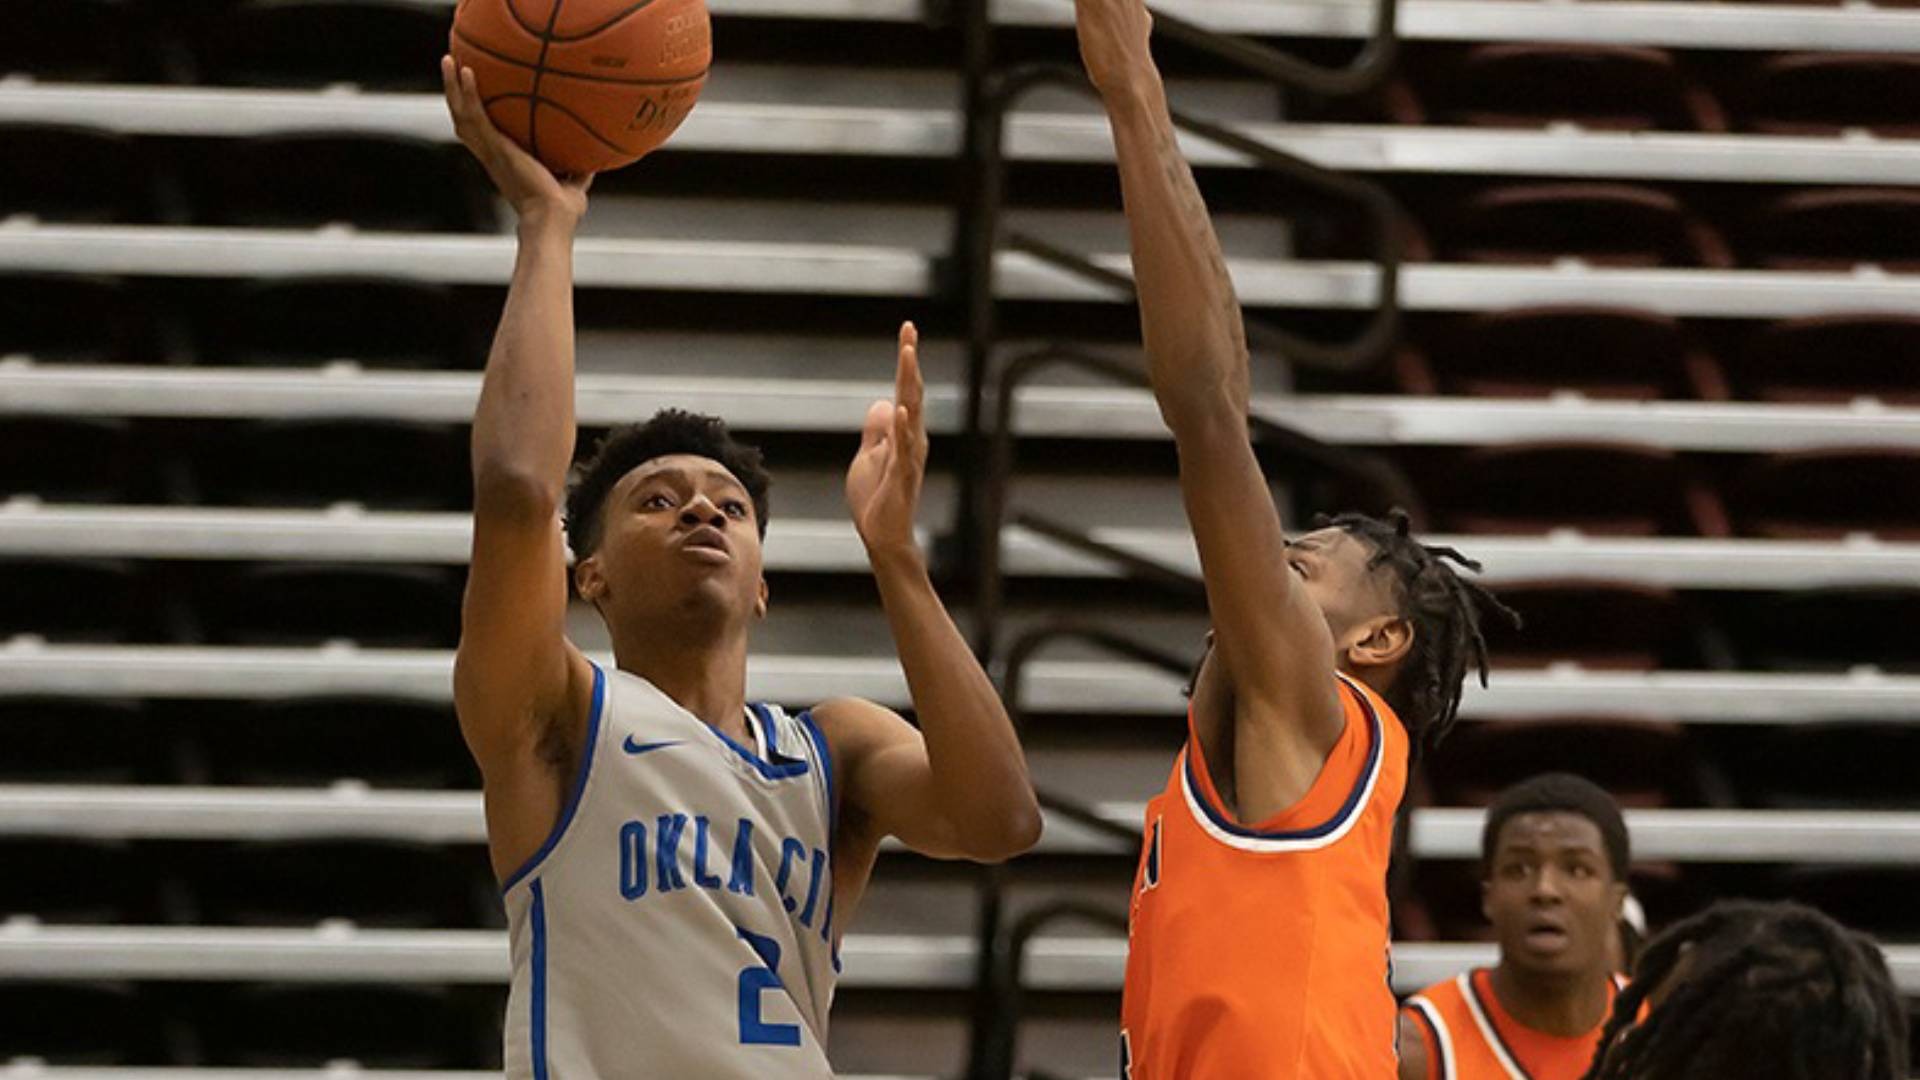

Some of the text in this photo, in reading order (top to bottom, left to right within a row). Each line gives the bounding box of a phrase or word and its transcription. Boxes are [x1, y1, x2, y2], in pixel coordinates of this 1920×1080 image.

[619, 813, 843, 974] OKLA CI
[736, 925, 801, 1046] 2
